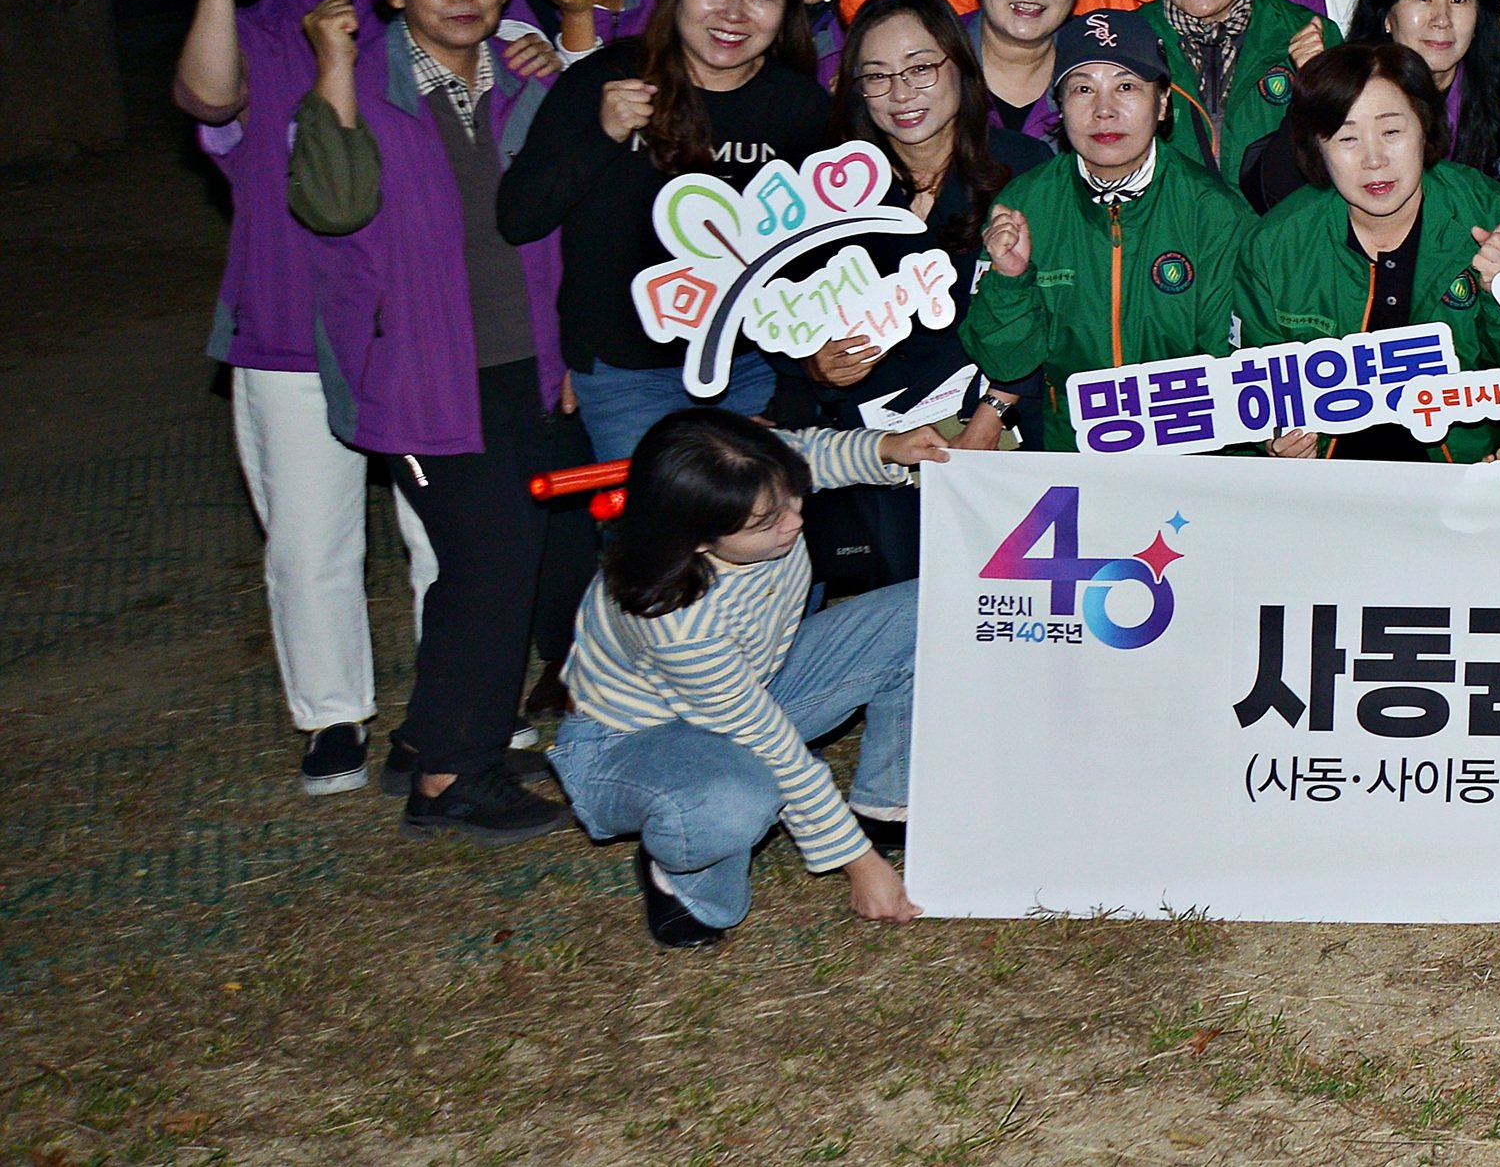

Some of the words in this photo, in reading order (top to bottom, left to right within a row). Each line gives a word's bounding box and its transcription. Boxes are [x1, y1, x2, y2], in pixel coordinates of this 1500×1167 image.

[1084, 14, 1118, 47] Sox
[753, 256, 869, 346] 함께
[1078, 366, 1216, 454] 명품
[1232, 334, 1450, 431] 해양동
[978, 486, 1175, 650] 40
[976, 621, 1083, 644] 승격40주년
[978, 595, 1032, 617] 안산시
